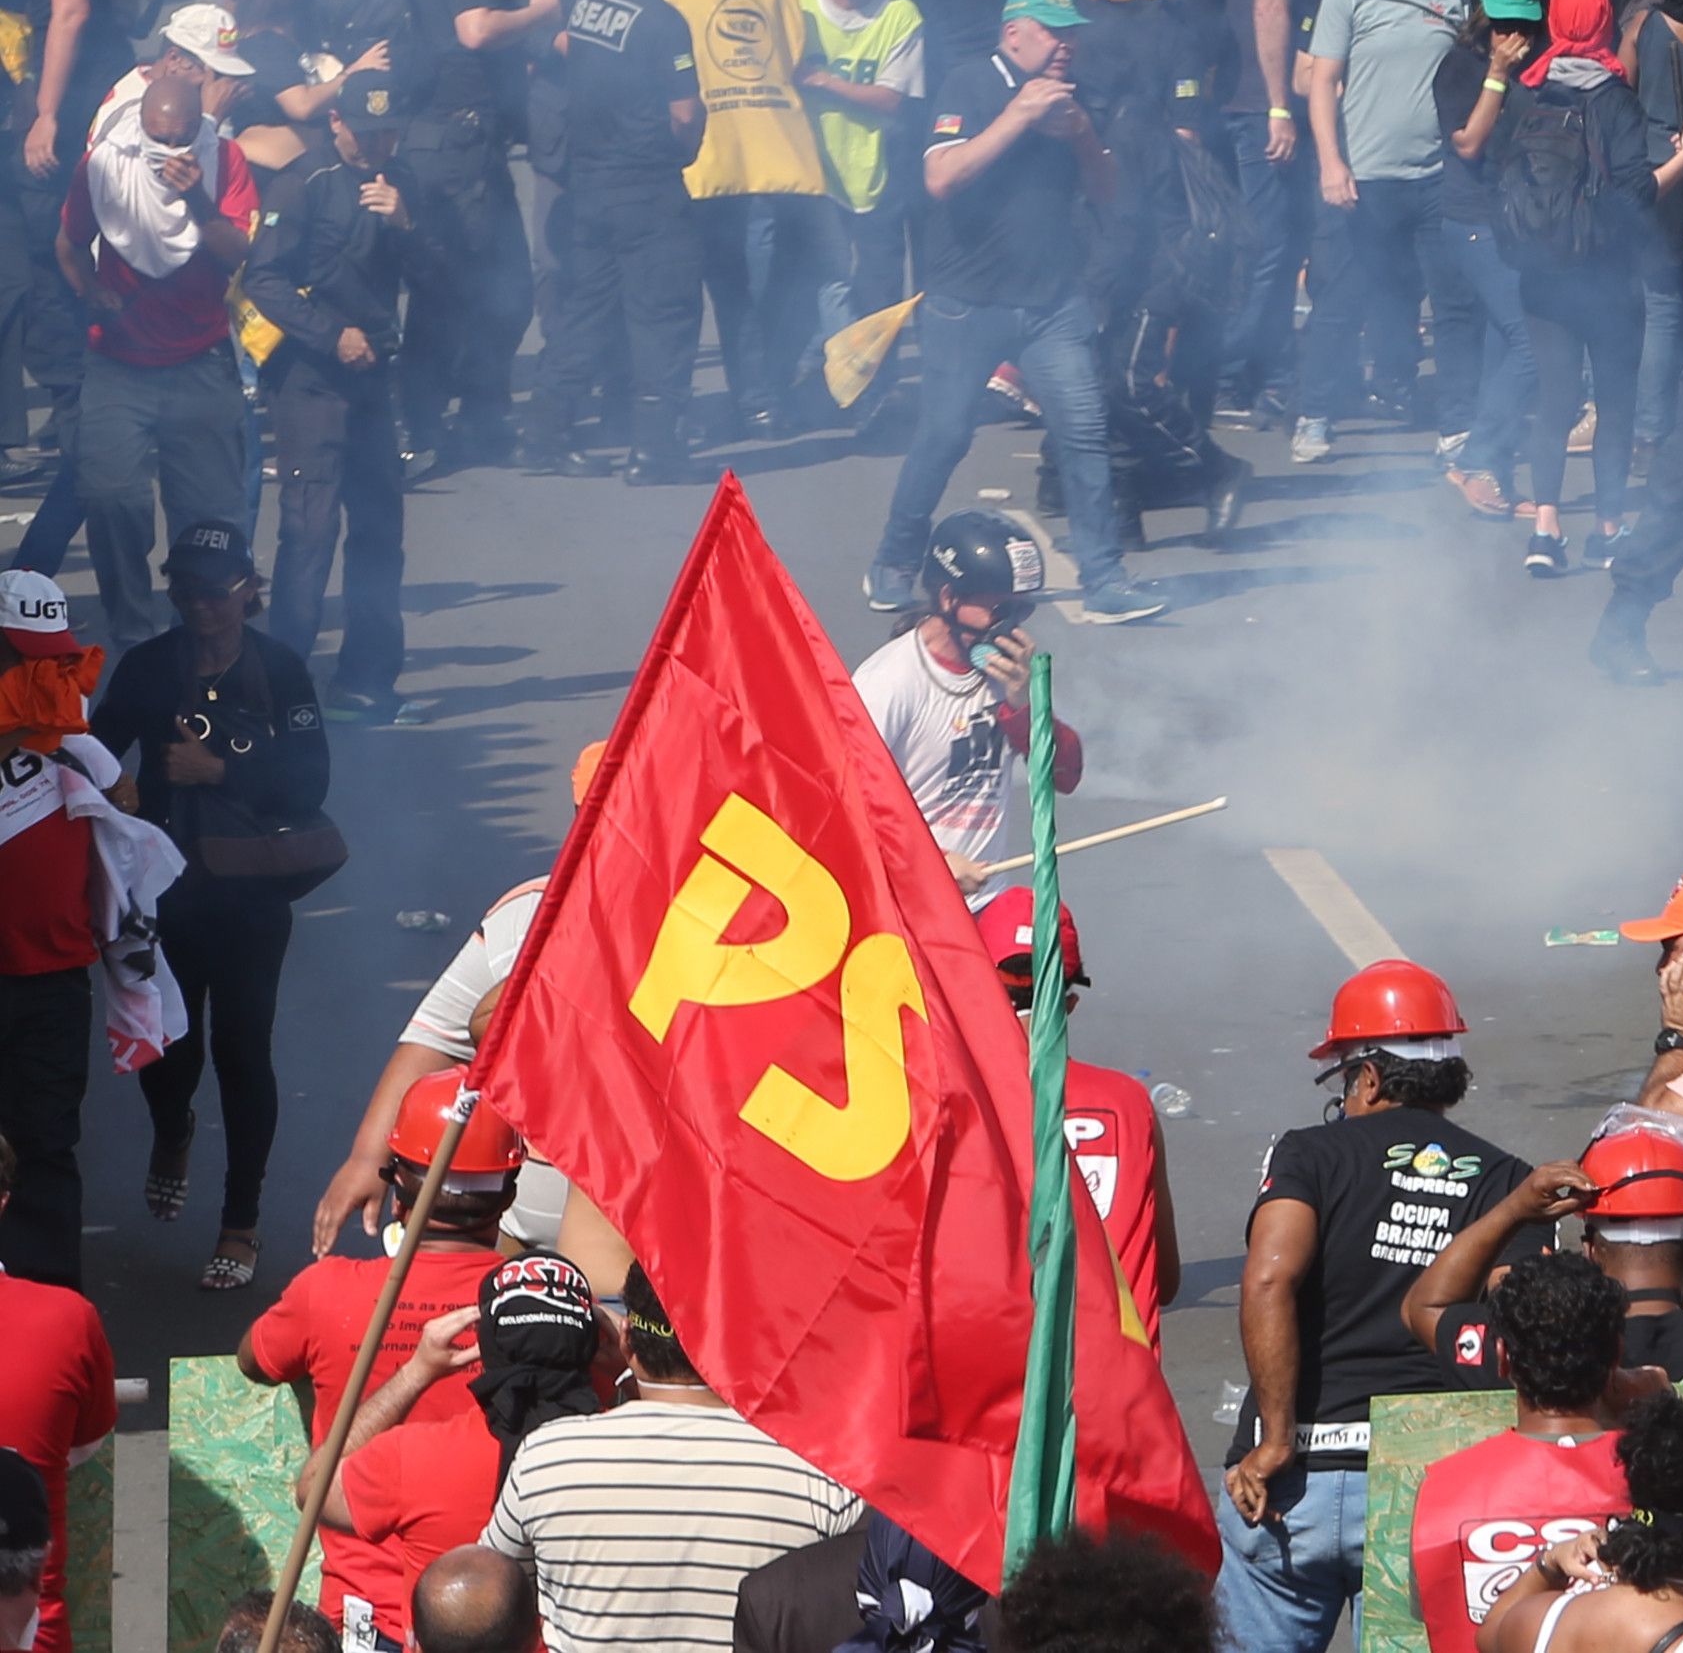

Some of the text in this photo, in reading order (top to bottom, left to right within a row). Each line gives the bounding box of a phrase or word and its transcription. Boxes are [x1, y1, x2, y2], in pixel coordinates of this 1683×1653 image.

[19, 599, 67, 621] UGT
[1391, 1170, 1469, 1198] EMPREGO
[1390, 1201, 1450, 1230] OCUPA
[1371, 1243, 1437, 1268] GREVE GER
